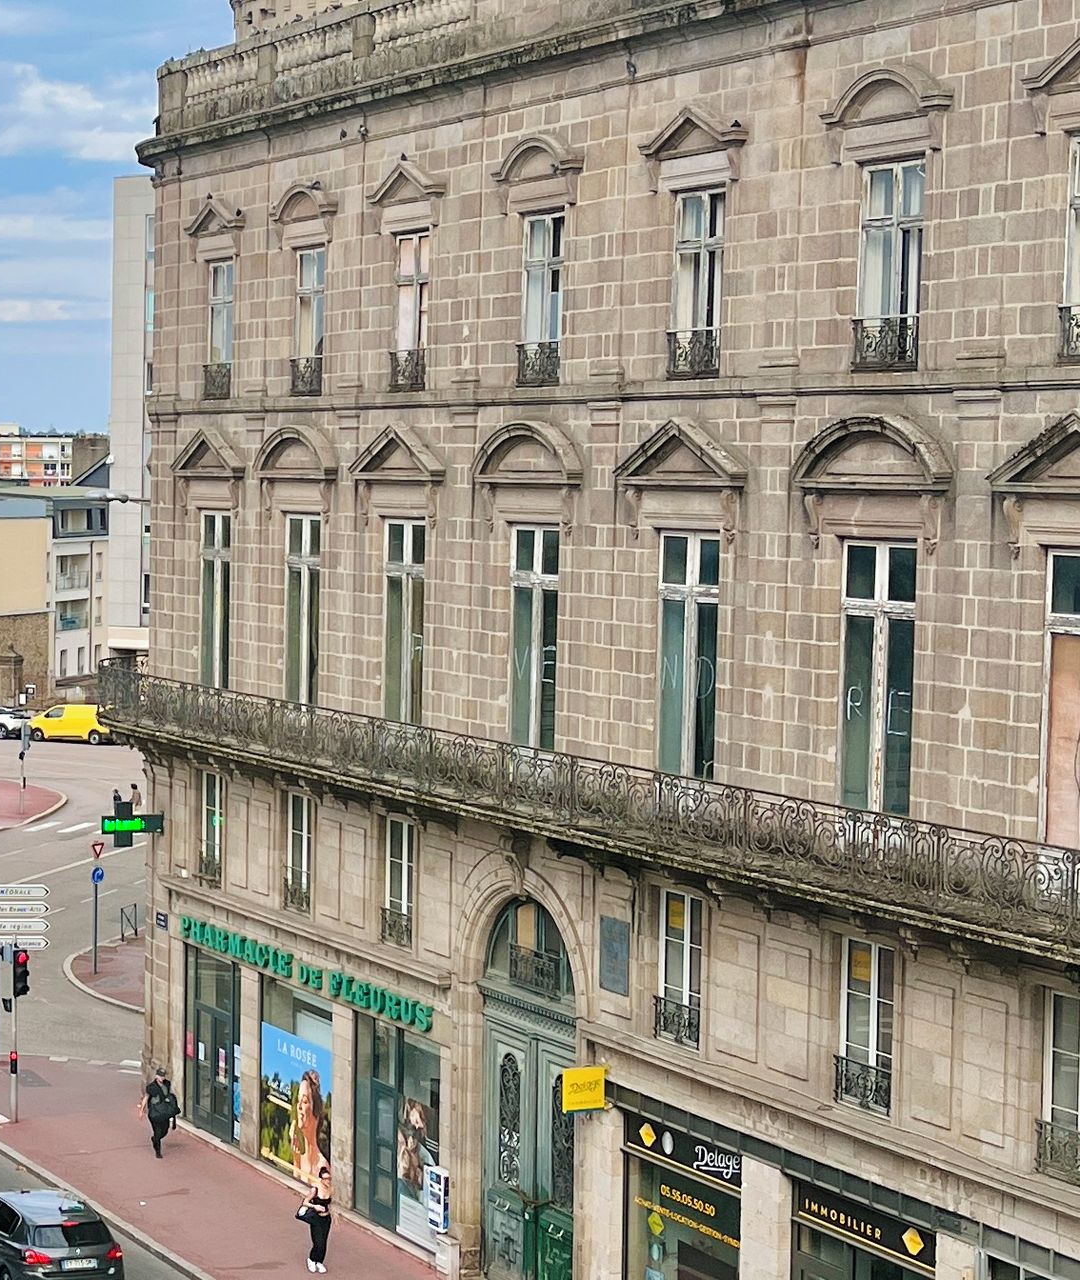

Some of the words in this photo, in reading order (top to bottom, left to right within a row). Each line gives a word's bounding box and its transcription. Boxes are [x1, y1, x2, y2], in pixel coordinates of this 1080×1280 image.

[179, 915, 295, 979] PHARMACIE
[297, 960, 323, 990] DE
[327, 971, 435, 1033] FLEURUS
[277, 1039, 289, 1056] LA
[290, 1043, 317, 1068] ROSÉE
[692, 1145, 741, 1179] Delage
[660, 1183, 716, 1218] 05.55.05.50.50
[805, 1197, 882, 1241] IMMOBILIER
